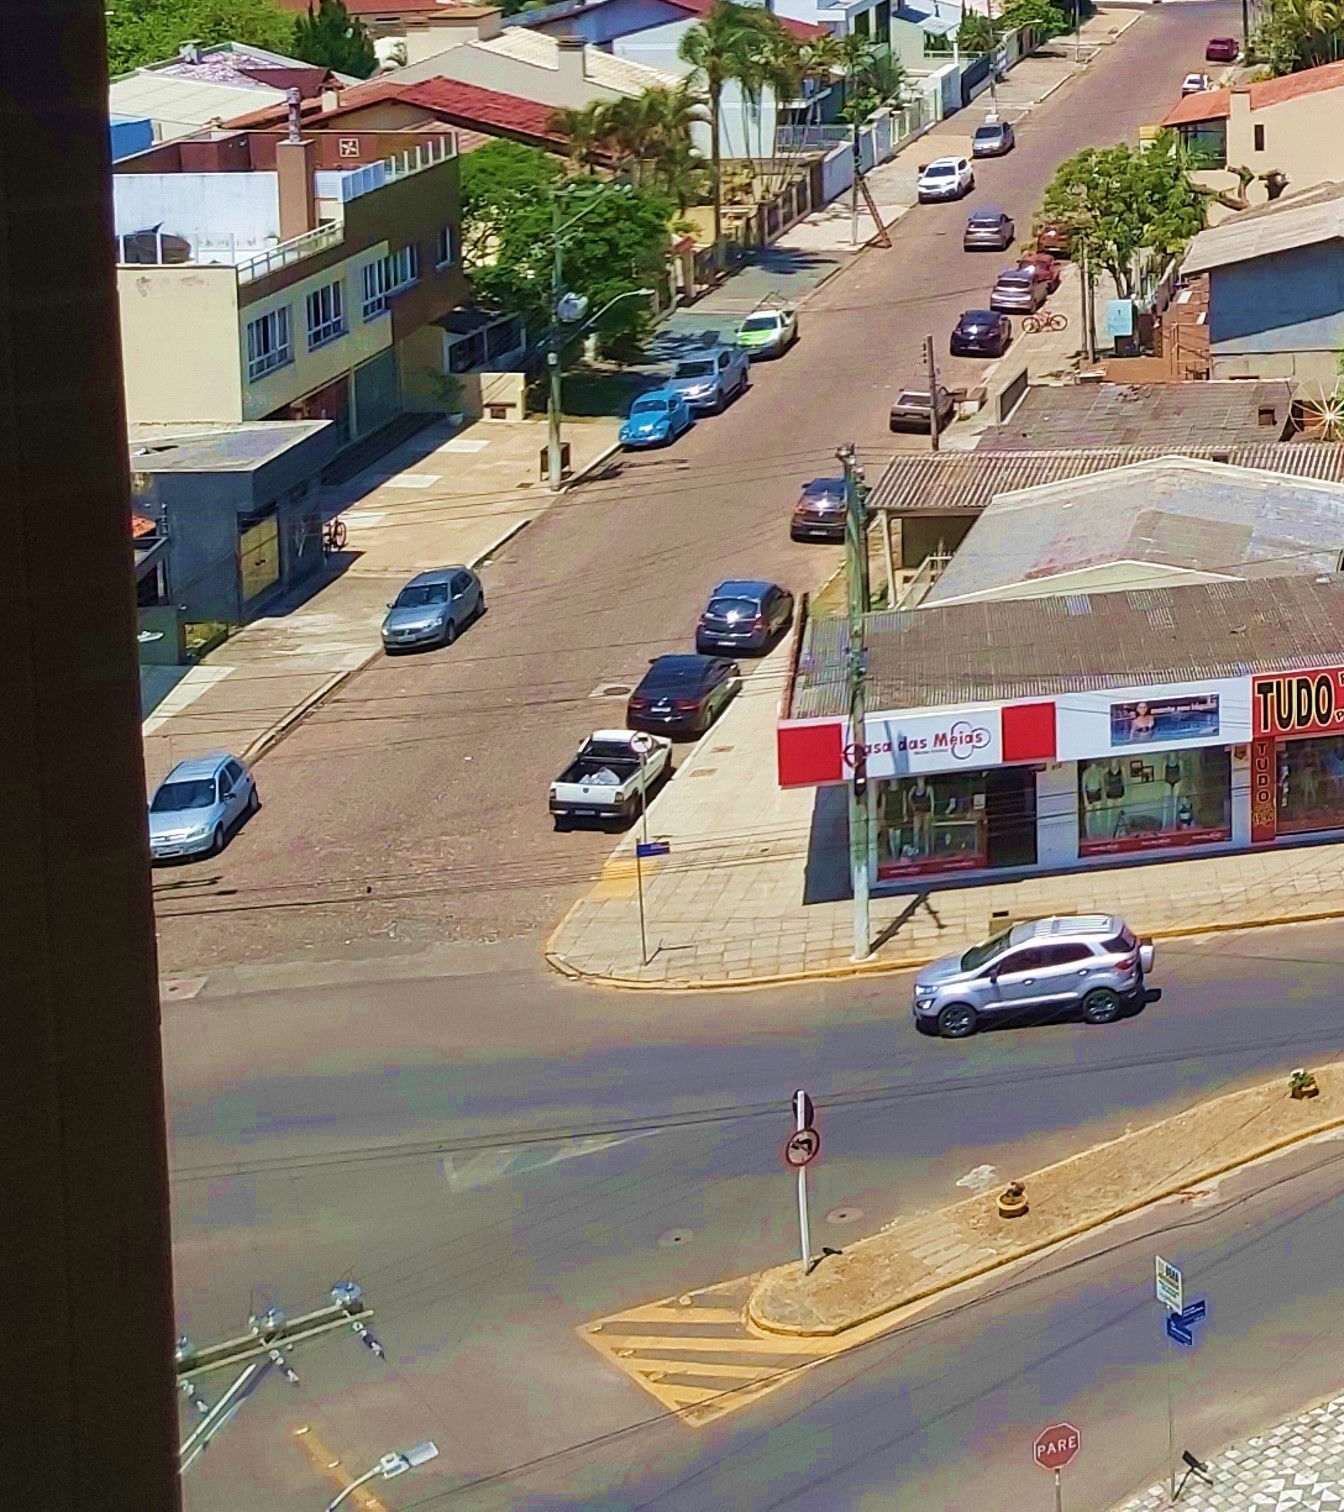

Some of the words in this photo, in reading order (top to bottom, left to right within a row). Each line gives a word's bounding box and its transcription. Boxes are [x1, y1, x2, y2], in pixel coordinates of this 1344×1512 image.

[1255, 674, 1335, 732] TUDO
[898, 735, 928, 752] das
[933, 730, 984, 748] Meias
[1255, 741, 1271, 804] TUDO
[1037, 1435, 1077, 1459] PARE
